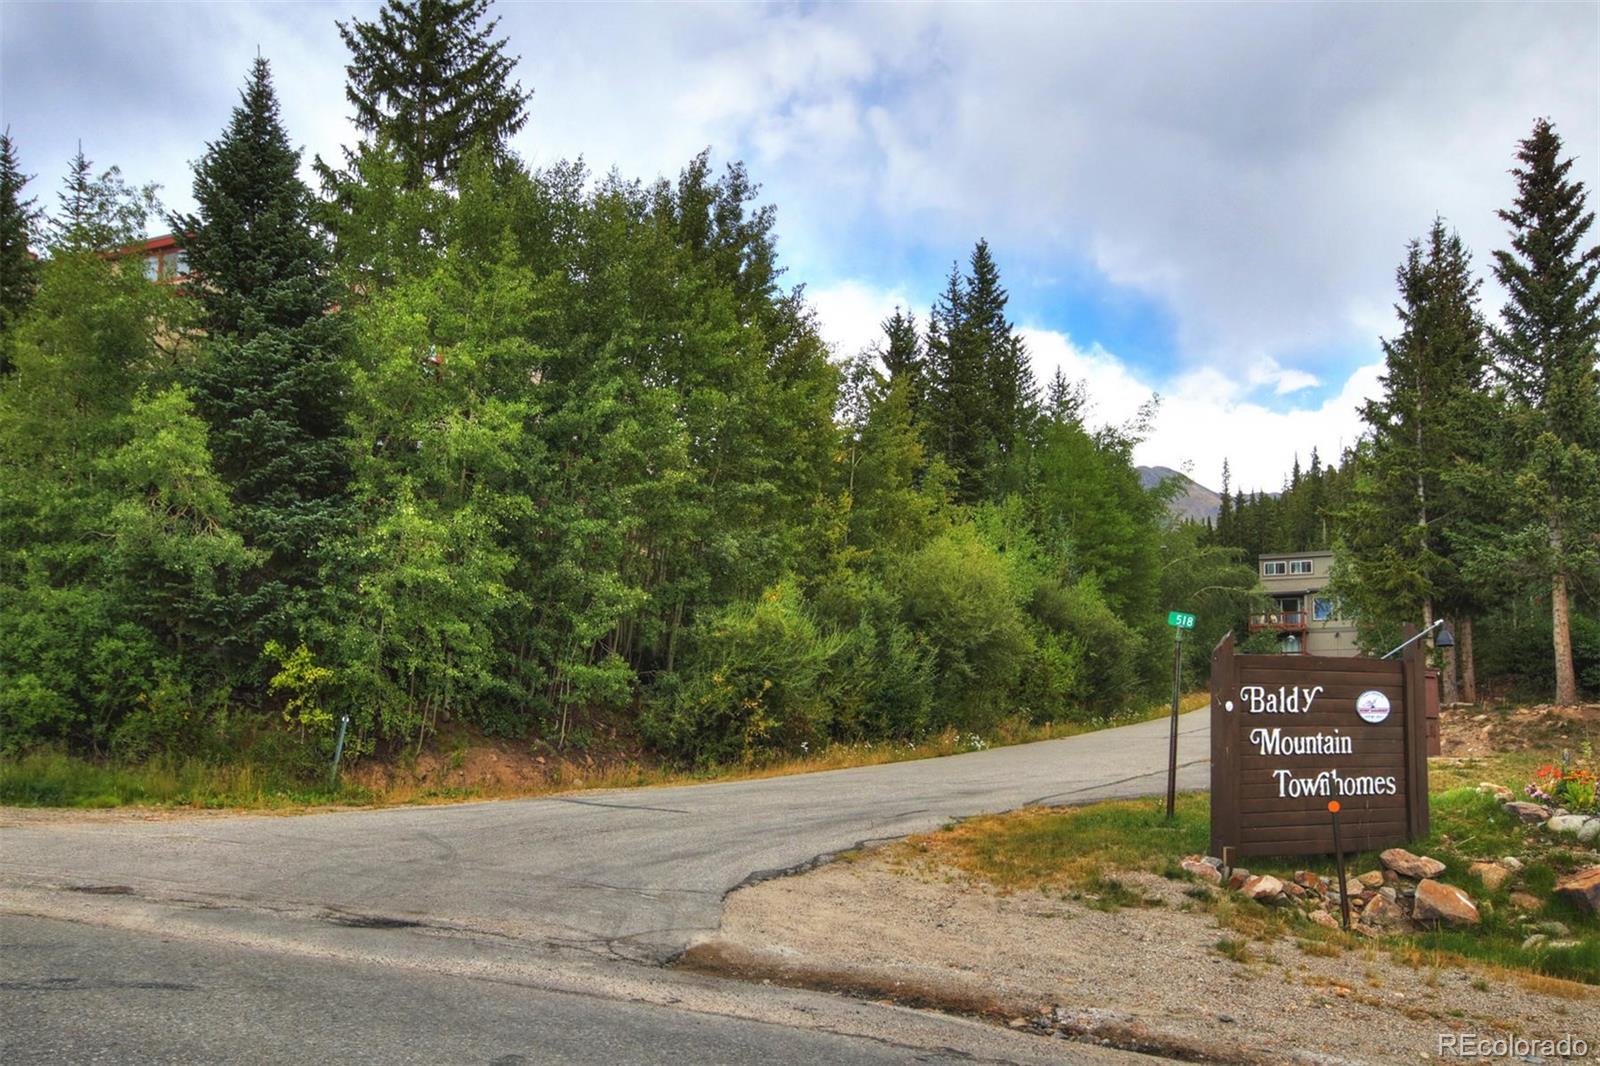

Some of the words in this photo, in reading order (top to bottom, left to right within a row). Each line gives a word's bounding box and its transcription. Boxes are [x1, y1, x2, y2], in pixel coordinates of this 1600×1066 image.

[1176, 614, 1194, 627] 518
[1240, 686, 1324, 713] Baldy
[1250, 728, 1352, 755] Mountain
